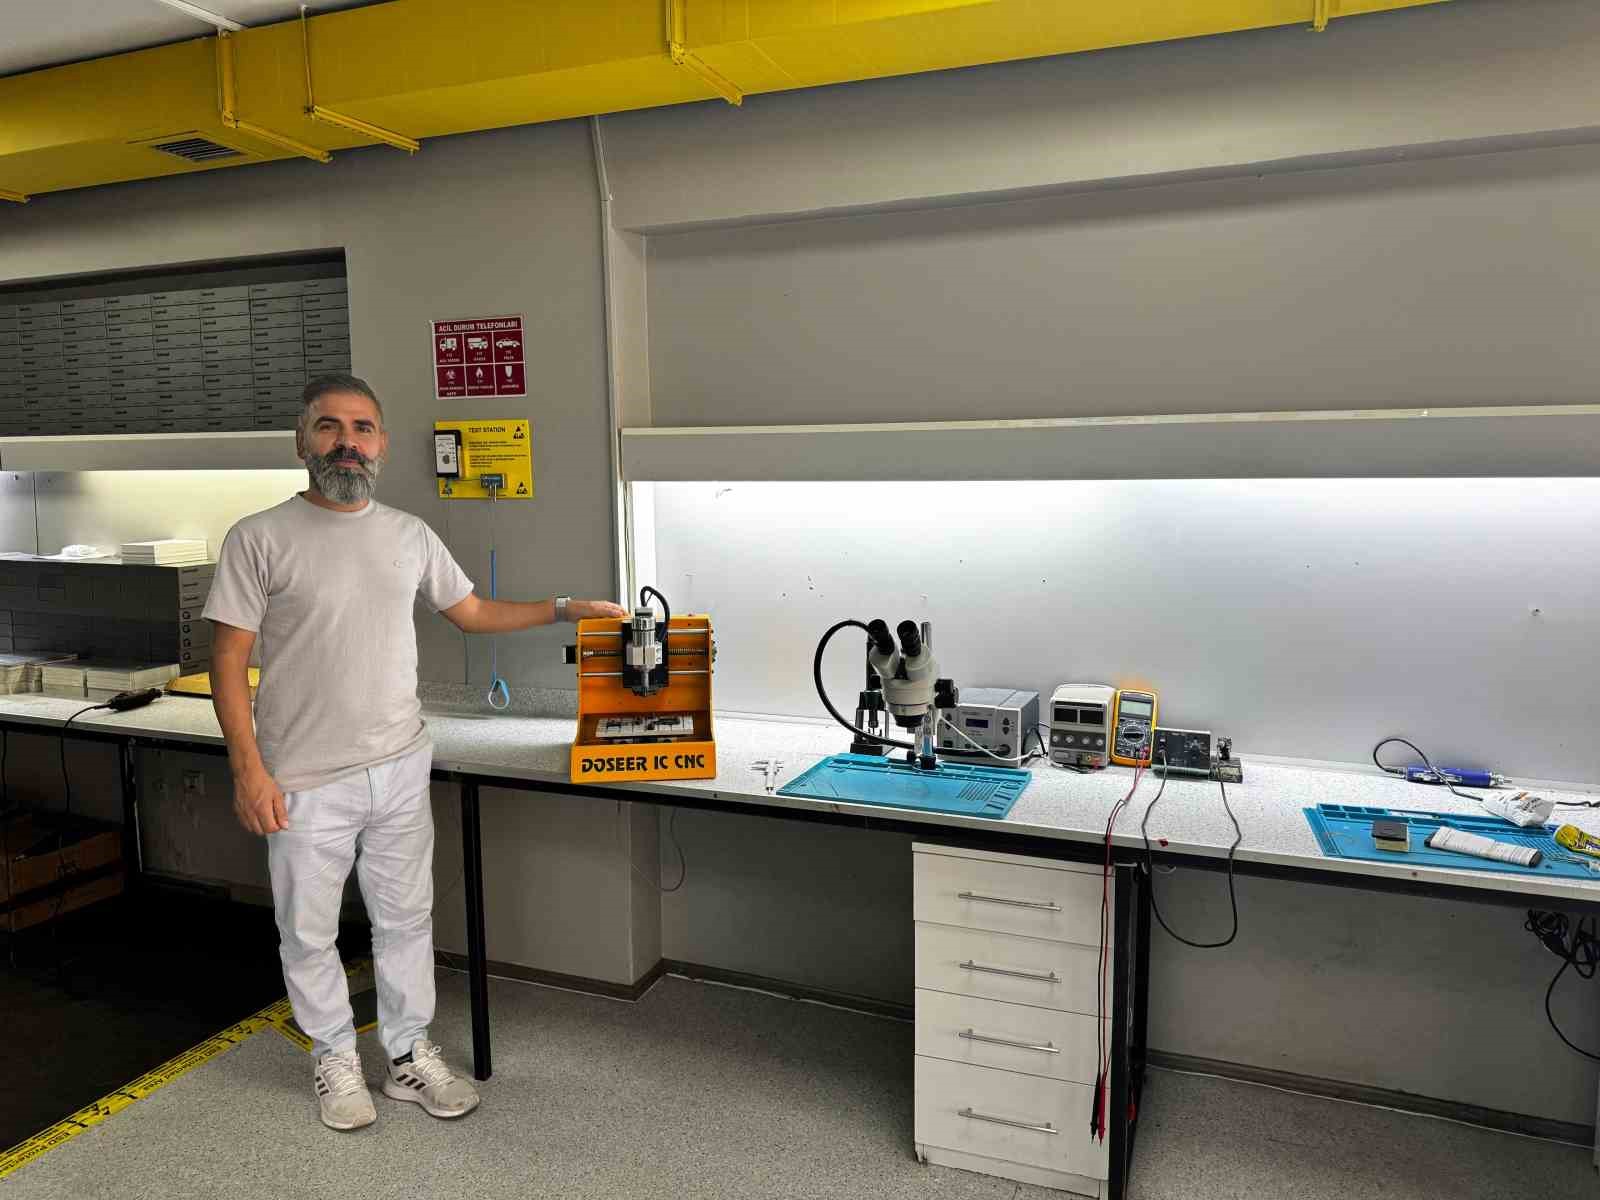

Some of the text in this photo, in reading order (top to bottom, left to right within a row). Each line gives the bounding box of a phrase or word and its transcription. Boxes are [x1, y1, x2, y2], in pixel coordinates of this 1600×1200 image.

[438, 320, 518, 332] ACİL DURUM TELEFONLARI
[581, 754, 705, 773] DOSEER IC CNC
